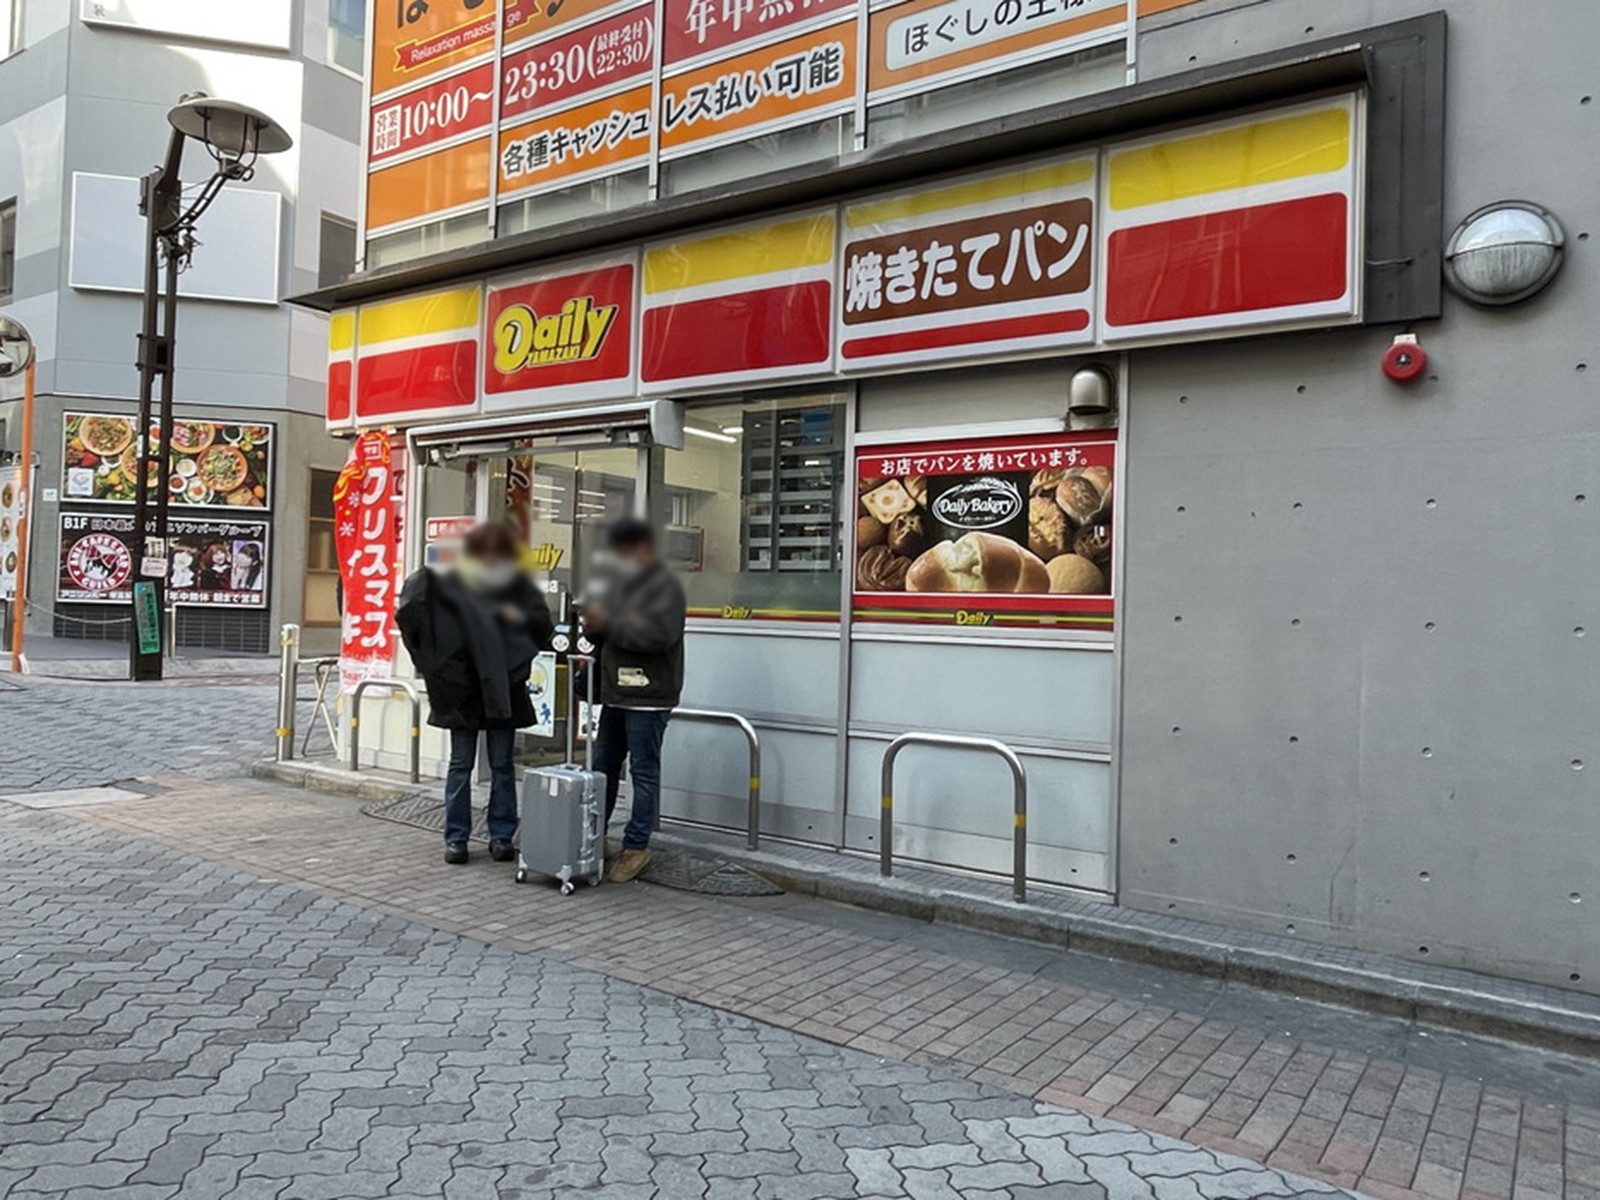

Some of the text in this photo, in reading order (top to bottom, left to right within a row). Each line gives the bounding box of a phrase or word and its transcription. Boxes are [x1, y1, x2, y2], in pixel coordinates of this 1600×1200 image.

[411, 34, 462, 63] Relaxation
[845, 218, 1089, 314] 焼きたてパン
[494, 297, 618, 374] Daily
[881, 447, 1088, 476] お店でパンを焼いています。
[939, 497, 1014, 516] Daily Bakery
[63, 517, 88, 530] B1F
[360, 466, 390, 648] クリスマス
[722, 605, 750, 619] Daily
[955, 609, 993, 626] Daily
